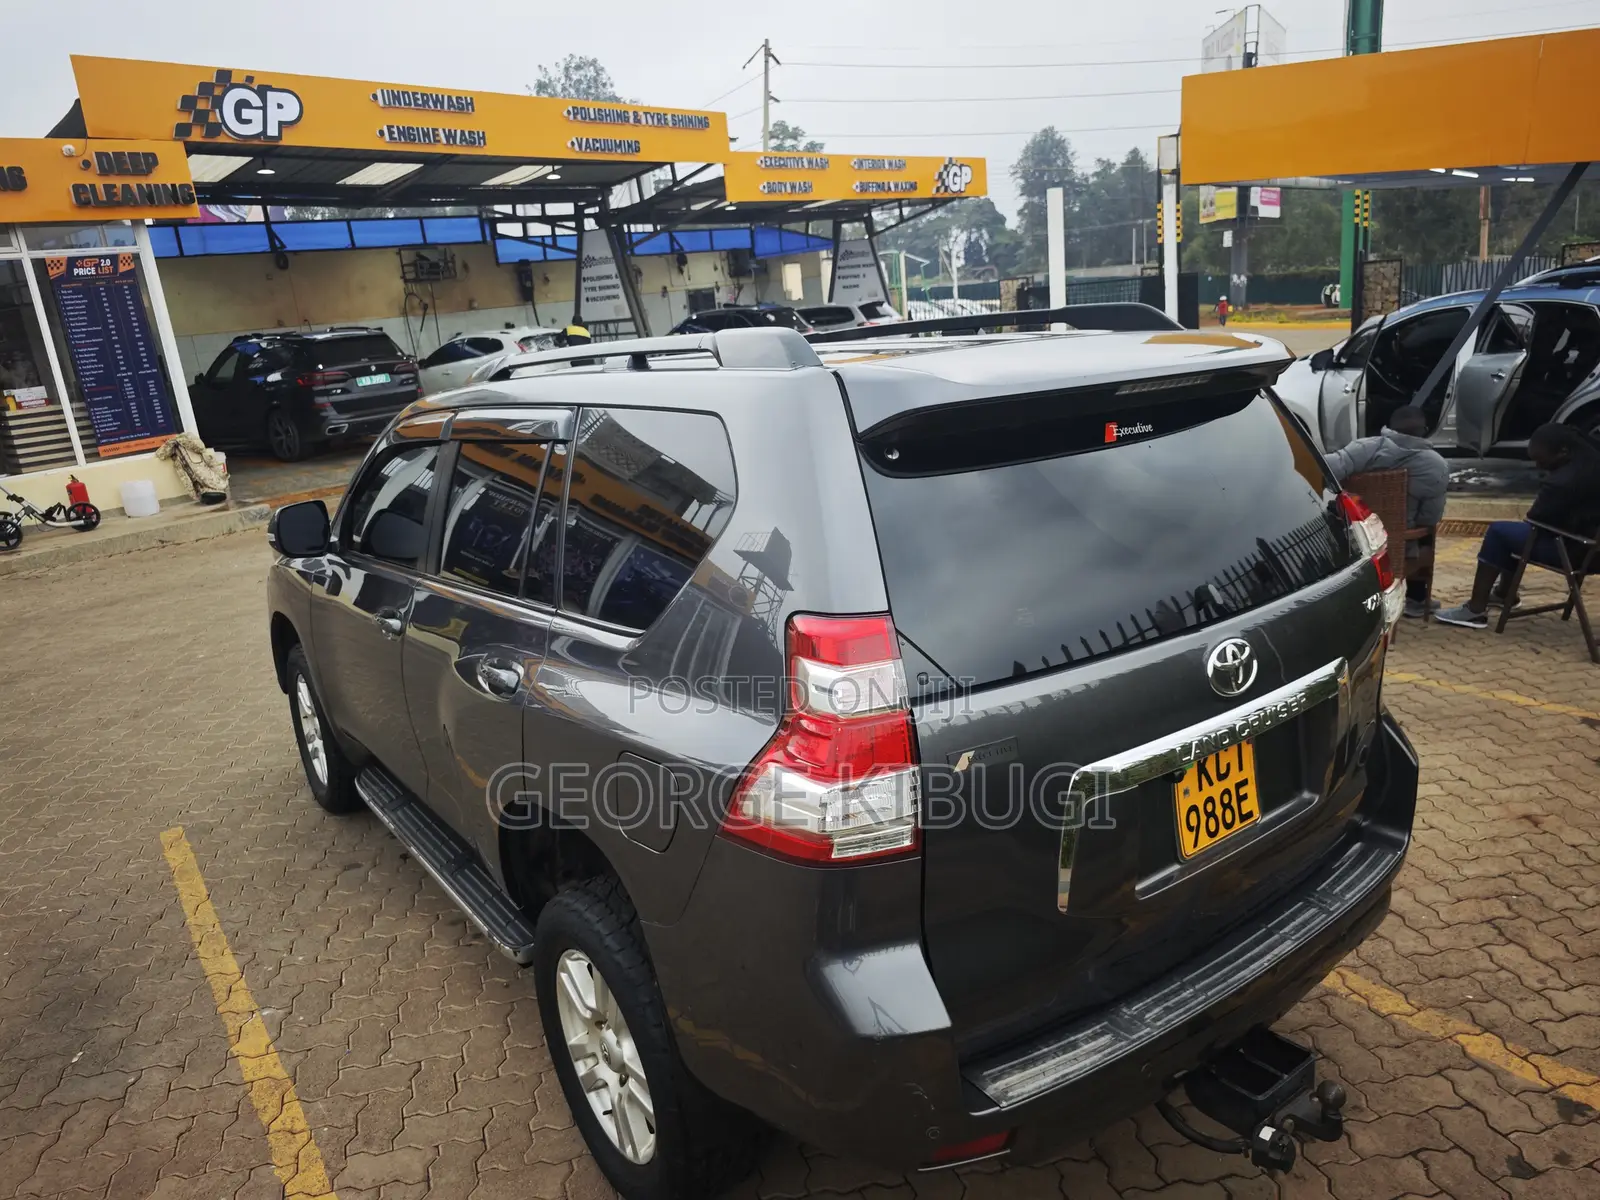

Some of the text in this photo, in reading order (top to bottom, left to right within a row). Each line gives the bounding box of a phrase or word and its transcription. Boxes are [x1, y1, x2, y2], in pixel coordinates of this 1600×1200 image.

[221, 85, 302, 139] GP
[377, 88, 475, 114] UNDERWASH
[570, 106, 710, 130] POLISHING & TYRE SHINING
[384, 124, 487, 147] ENGINE WASH
[574, 136, 641, 154] VACUUMING
[93, 151, 160, 176] DEEP
[762, 156, 829, 169] EXECUTIVE WASH
[886, 159, 906, 170] WASH
[765, 181, 813, 194] BODY WASH
[948, 164, 973, 193] GP
[70, 183, 197, 207] CLEANING
[73, 265, 115, 276] PRICE LIST
[100, 258, 111, 267] 2.0
[1109, 422, 1154, 438] Executive
[1176, 691, 1307, 762] LAND CRUISER
[1185, 777, 1254, 849] 988E
